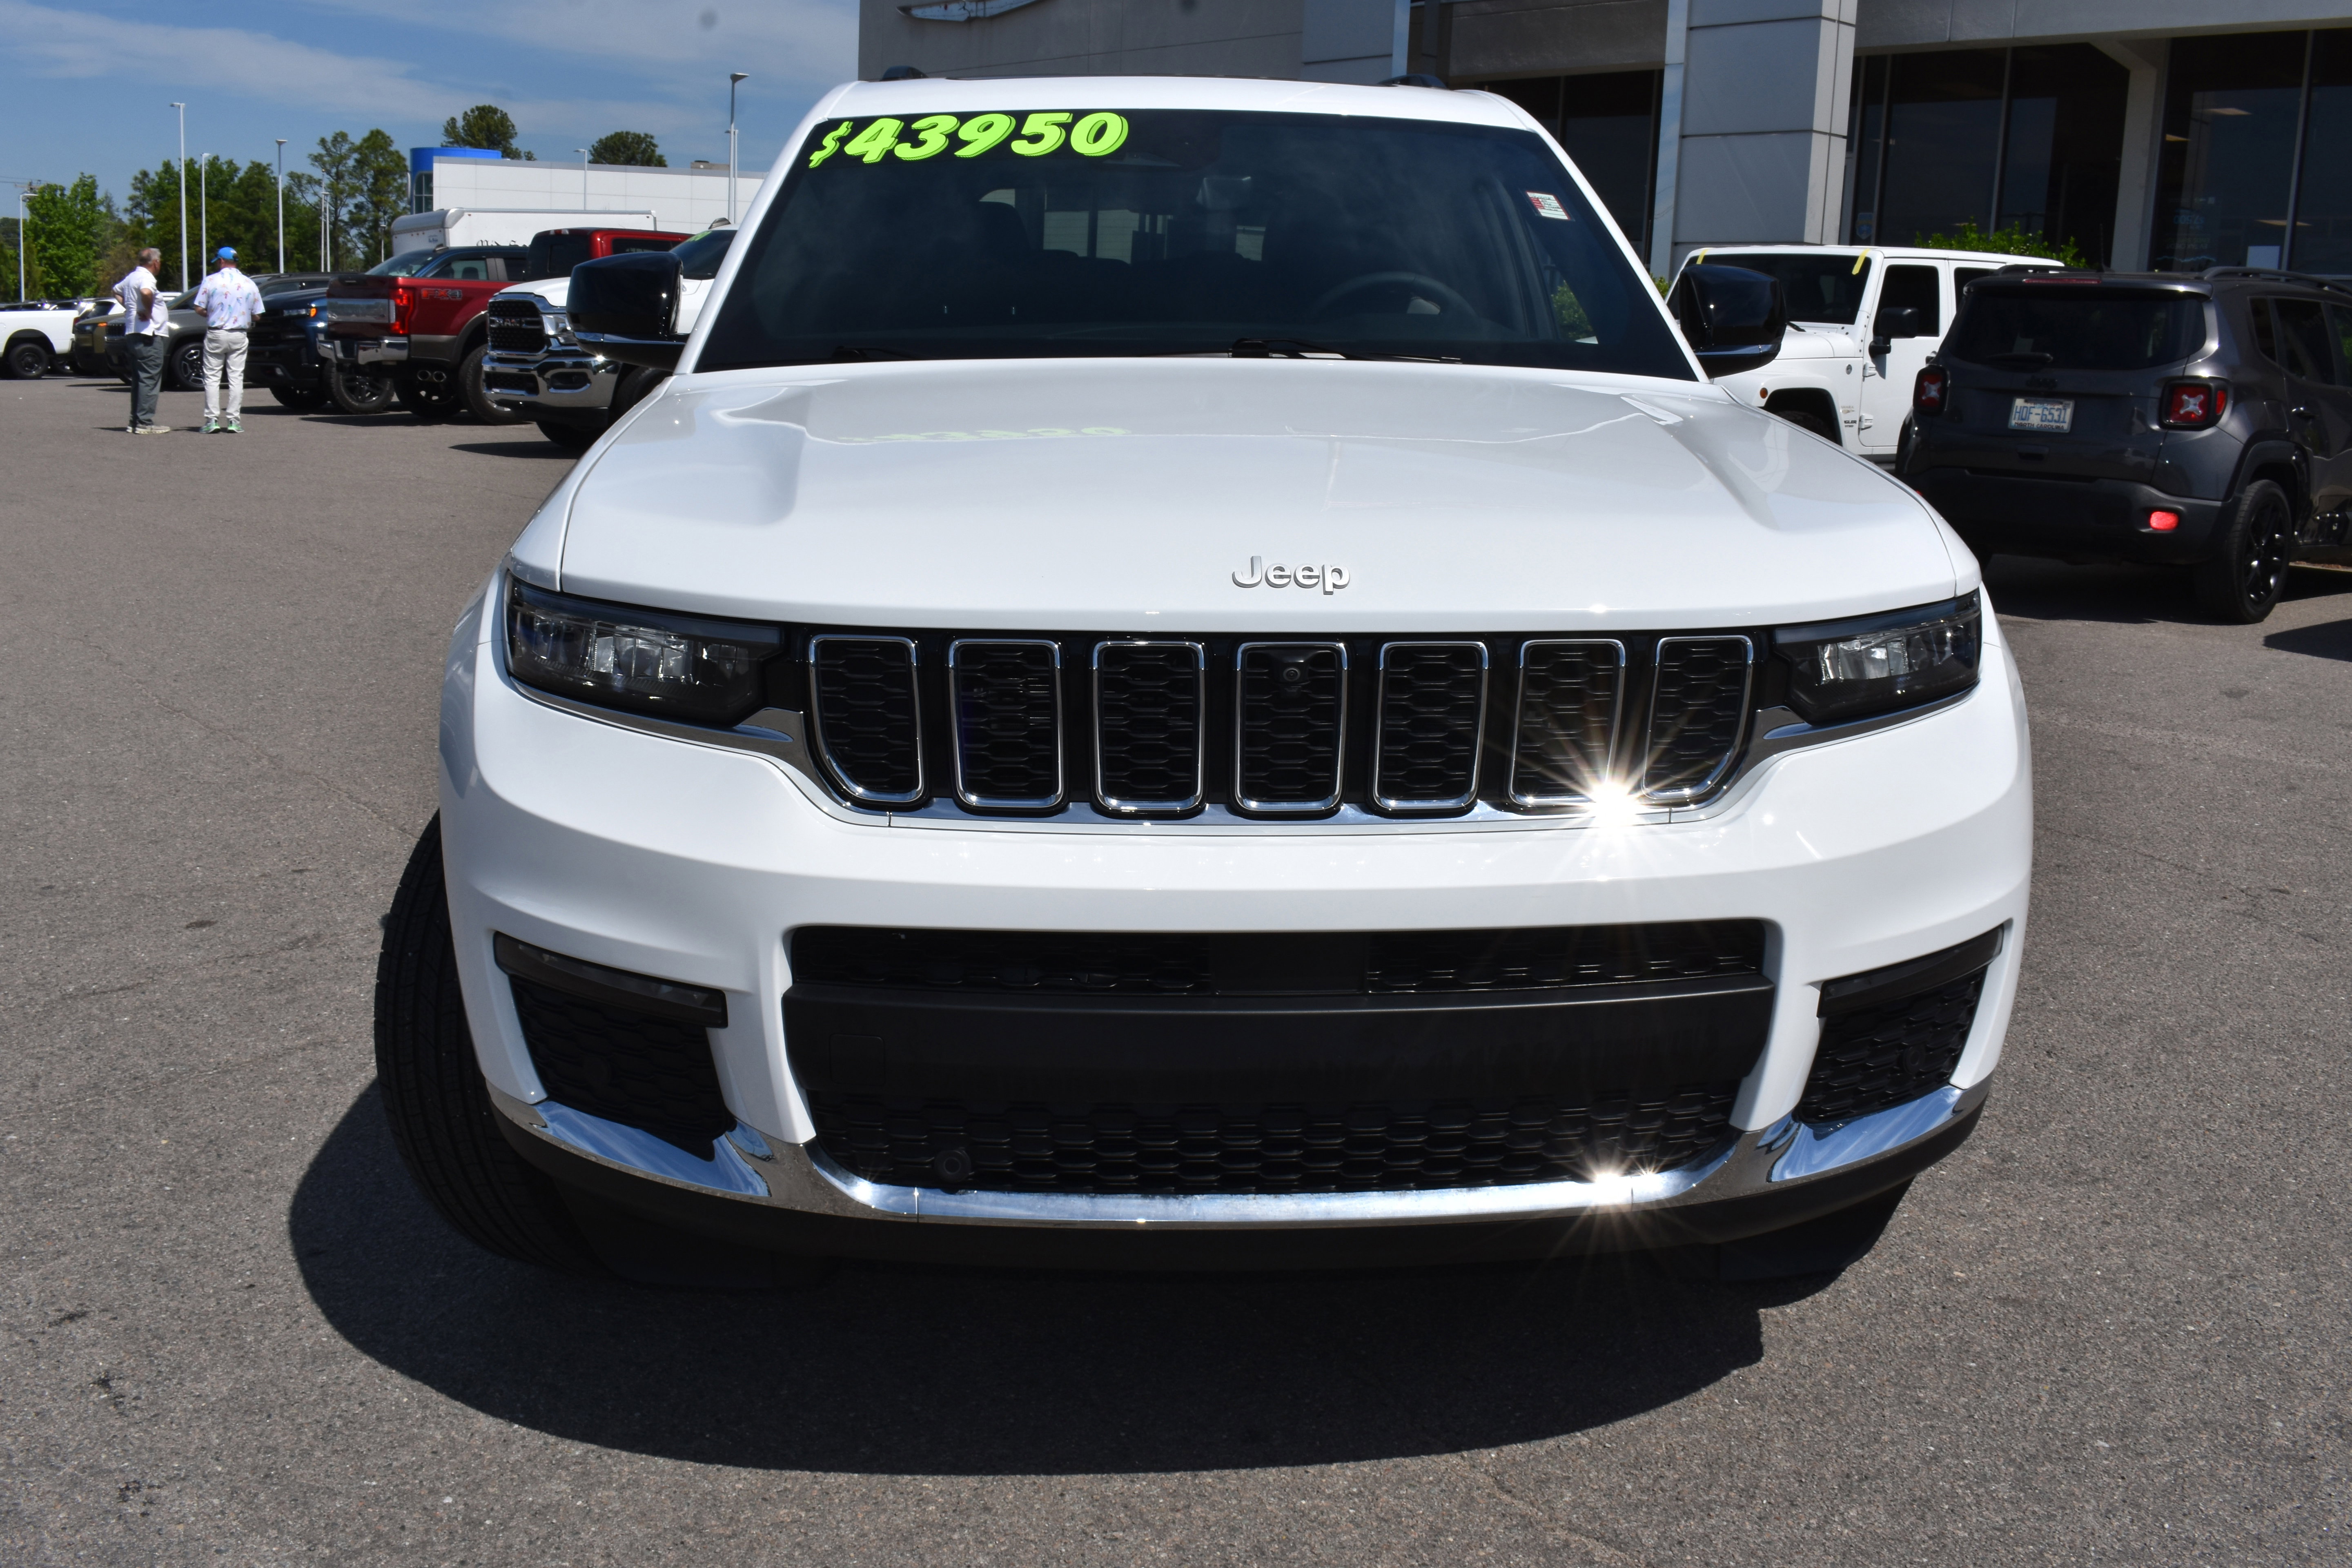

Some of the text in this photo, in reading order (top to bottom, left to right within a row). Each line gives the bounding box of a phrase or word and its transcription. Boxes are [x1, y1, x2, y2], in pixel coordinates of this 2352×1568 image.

[809, 112, 1128, 168] $43950
[421, 288, 462, 300] FX4
[496, 317, 520, 327] RAM
[1232, 555, 1350, 595] Jeep
